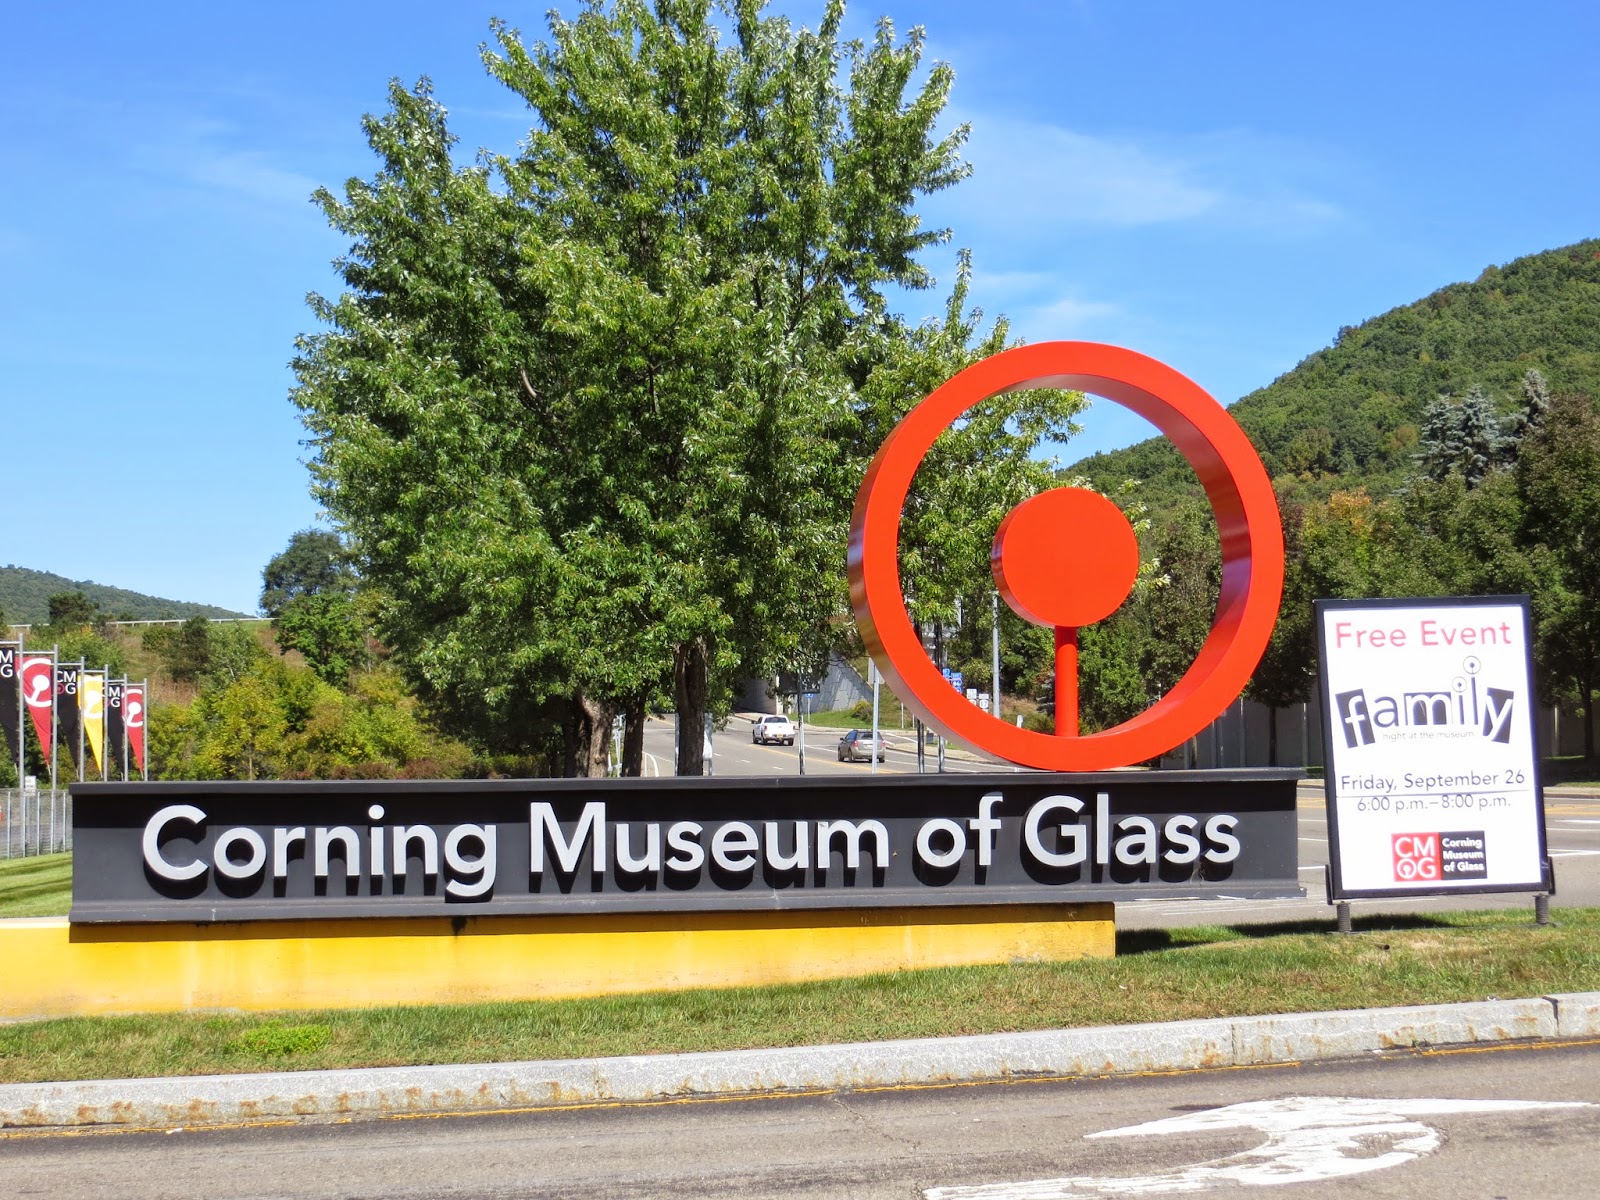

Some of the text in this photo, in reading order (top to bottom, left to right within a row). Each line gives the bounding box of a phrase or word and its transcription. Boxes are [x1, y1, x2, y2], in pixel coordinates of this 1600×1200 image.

[1335, 620, 1512, 648] Free Event
[1335, 656, 1514, 748] family
[1382, 732, 1406, 742] night
[1419, 731, 1434, 739] the
[1437, 731, 1475, 739] museum
[1341, 770, 1525, 793] Friday, September 26
[1357, 796, 1390, 812] 6:00
[1479, 795, 1511, 811] p.m.
[142, 791, 1240, 897] Corning Museum of Glass
[1395, 836, 1435, 858] CM
[1442, 837, 1482, 848] Corning
[1443, 850, 1484, 860] Museum
[1443, 861, 1484, 872] of Glass
